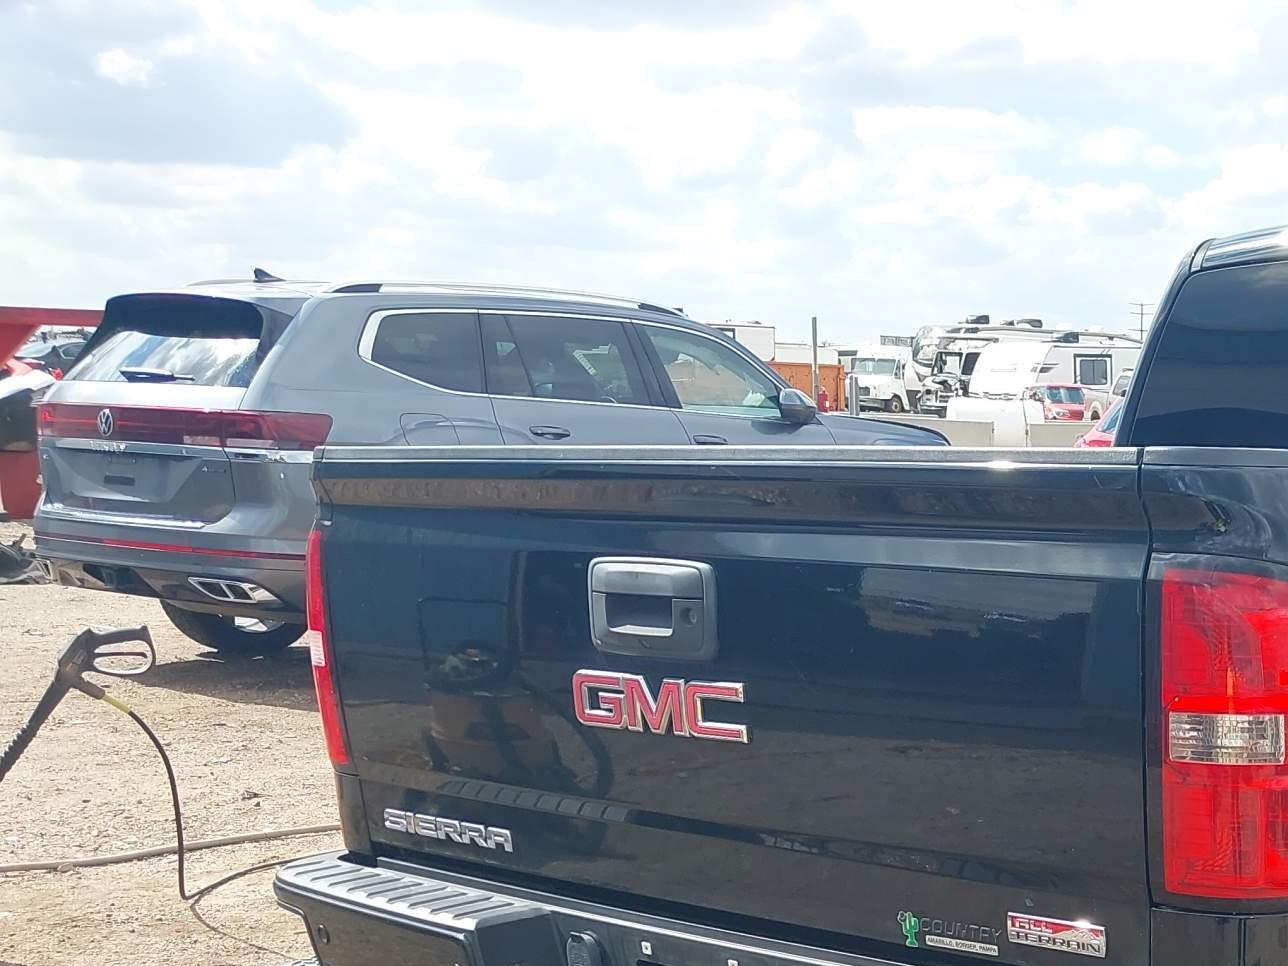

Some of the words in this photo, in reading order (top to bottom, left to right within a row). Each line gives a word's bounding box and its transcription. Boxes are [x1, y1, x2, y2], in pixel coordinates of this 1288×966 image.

[571, 668, 751, 744] GMC
[383, 807, 514, 854] SIERRA
[1011, 917, 1053, 932] ALL
[978, 945, 997, 954] PAMPA
[1010, 930, 1101, 953] TERRAIN
